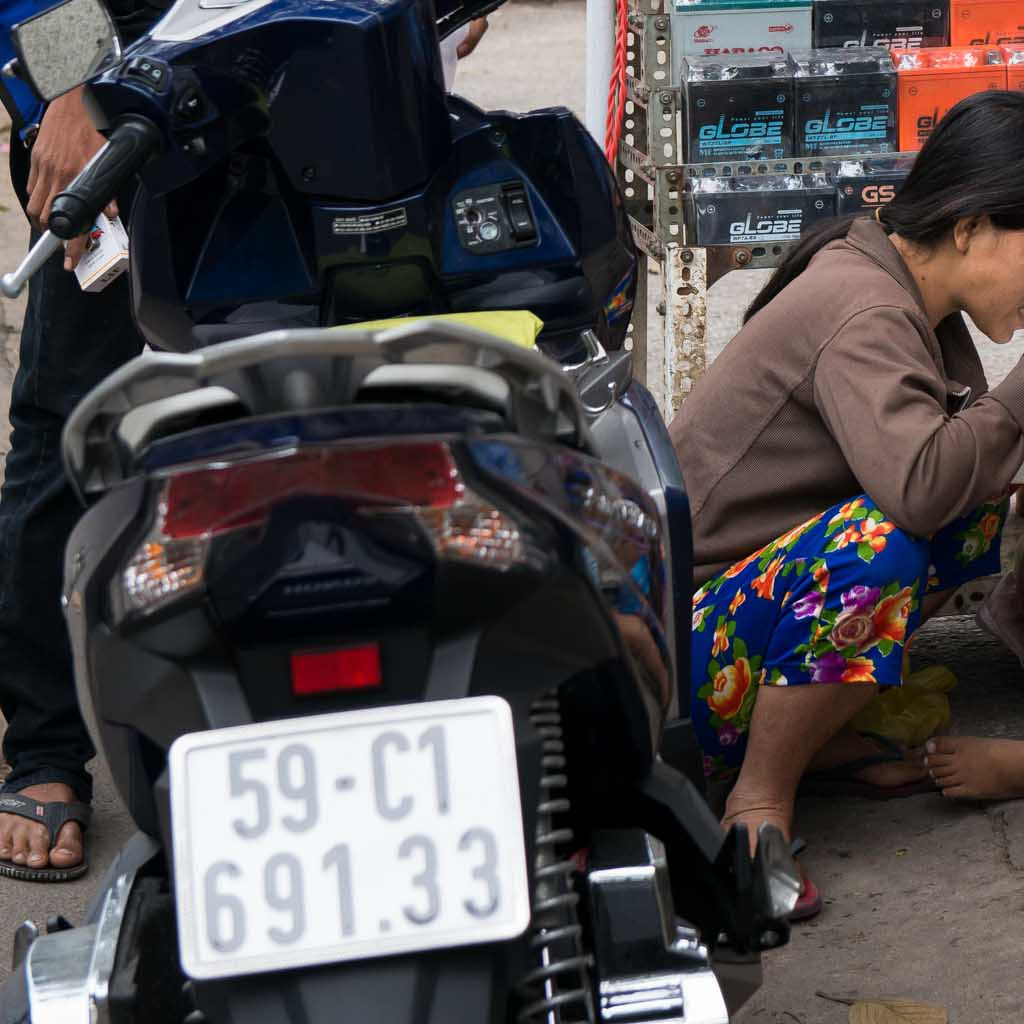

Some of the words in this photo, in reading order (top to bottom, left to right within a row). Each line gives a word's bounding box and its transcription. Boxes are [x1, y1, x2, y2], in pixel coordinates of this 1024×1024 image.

[699, 113, 784, 140] GLOBE
[805, 108, 889, 134] GLOBE
[861, 185, 896, 203] GS
[729, 212, 802, 235] GLOBE
[228, 724, 451, 840] 59-C1
[203, 826, 501, 954] 691.33
